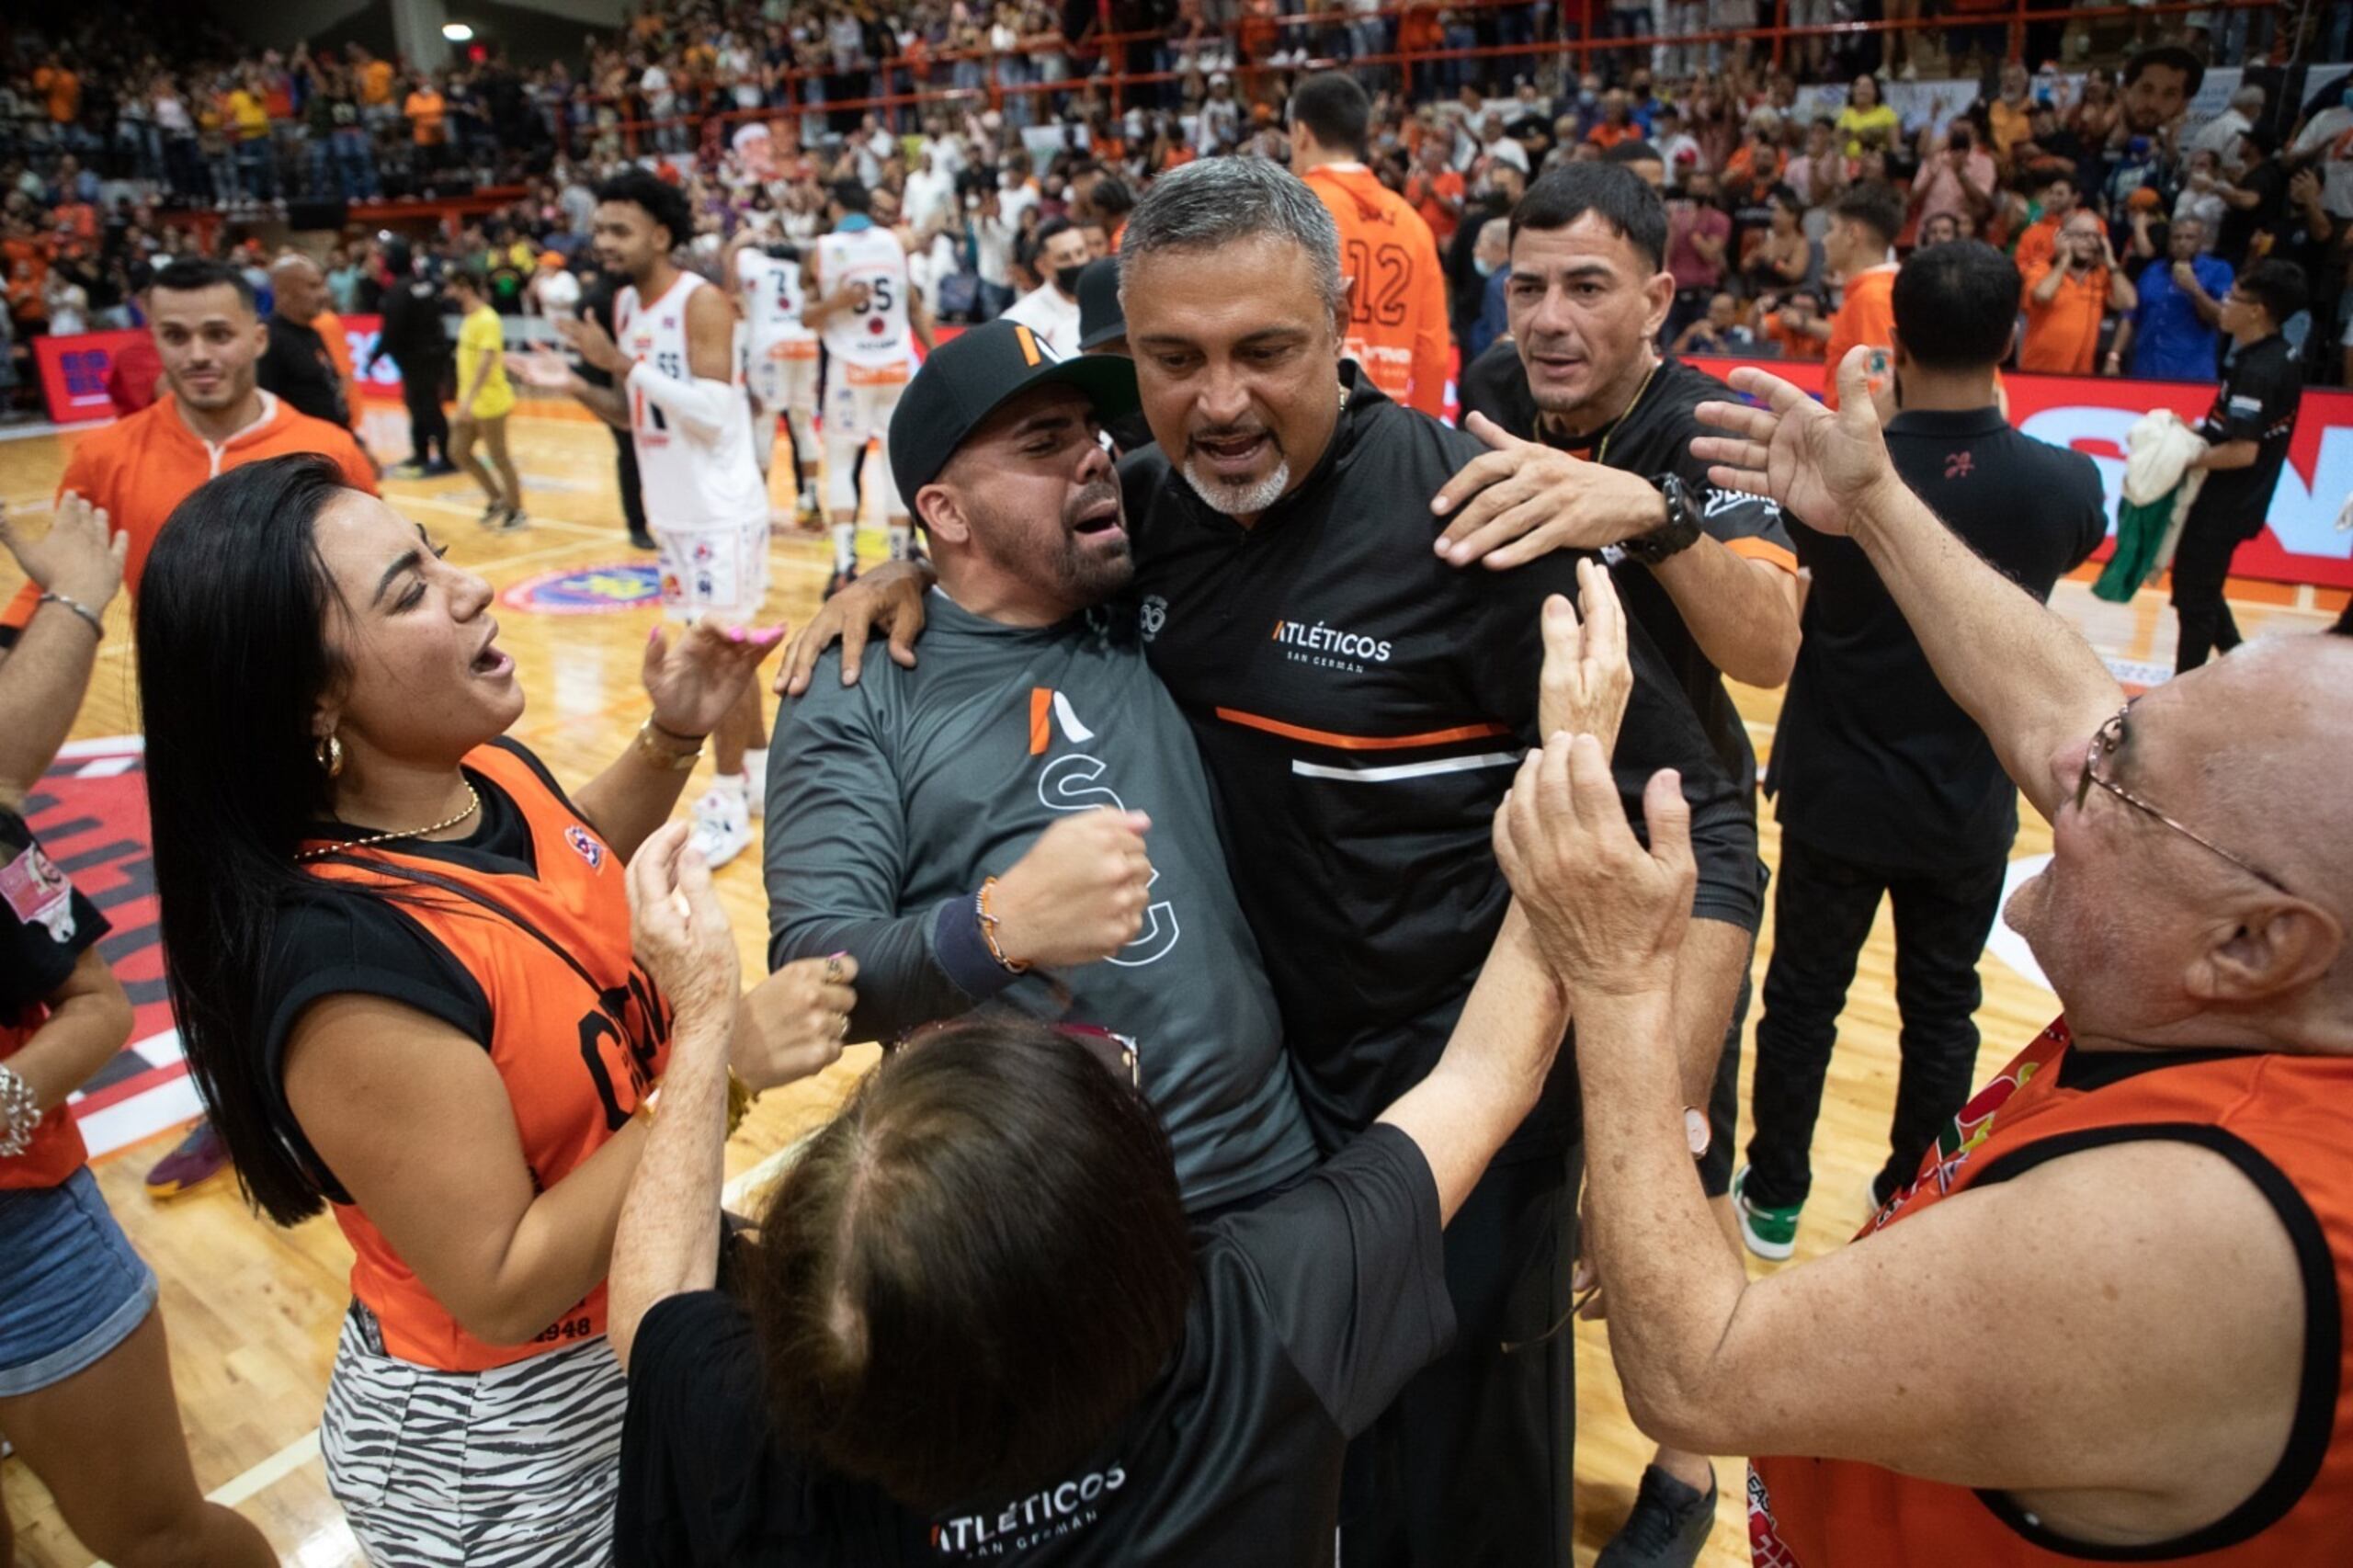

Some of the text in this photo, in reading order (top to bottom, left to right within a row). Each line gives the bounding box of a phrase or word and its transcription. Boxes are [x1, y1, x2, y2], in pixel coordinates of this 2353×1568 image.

[1347, 239, 1413, 326] 12
[1272, 620, 1392, 662] ATLÉTICOS
[1287, 651, 1308, 663] SAN
[931, 1463, 1126, 1552] ATLÉTICOS
[967, 1544, 1004, 1560] AN
